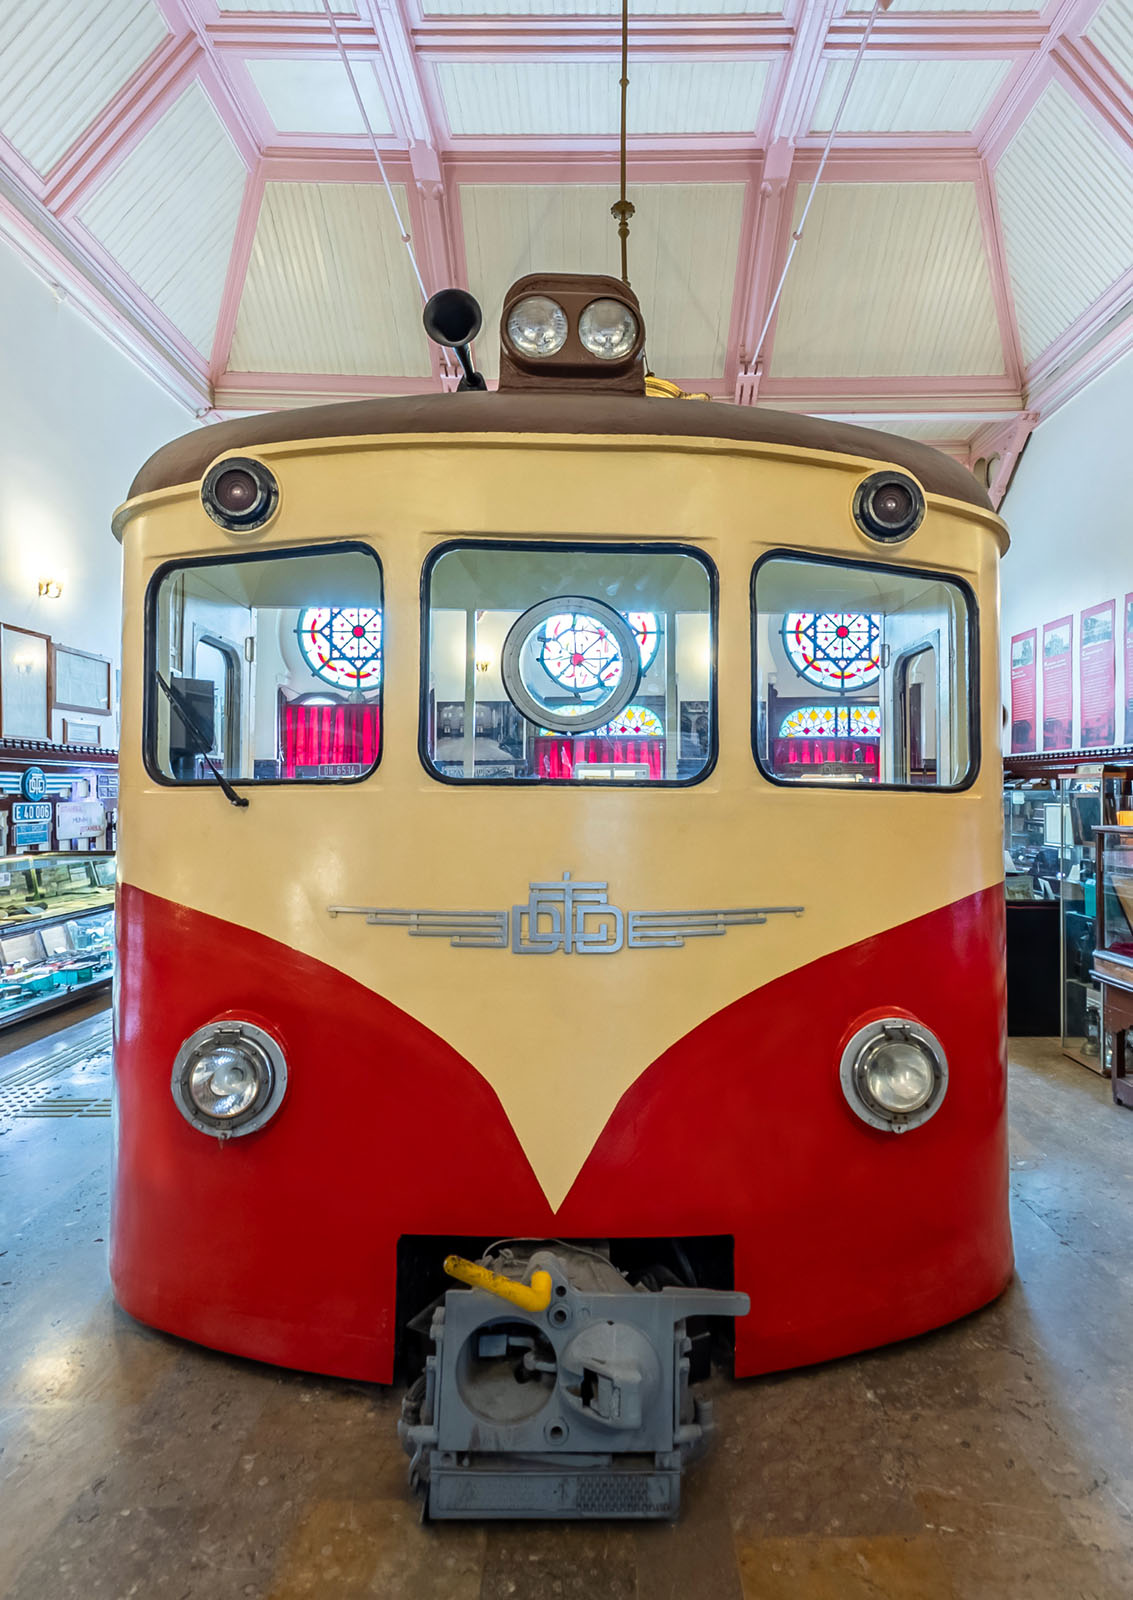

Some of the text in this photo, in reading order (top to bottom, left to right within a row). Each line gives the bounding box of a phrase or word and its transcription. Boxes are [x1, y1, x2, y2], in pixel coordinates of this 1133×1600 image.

[16, 806, 21, 819] E
[24, 805, 34, 819] 40
[36, 805, 49, 819] 006
